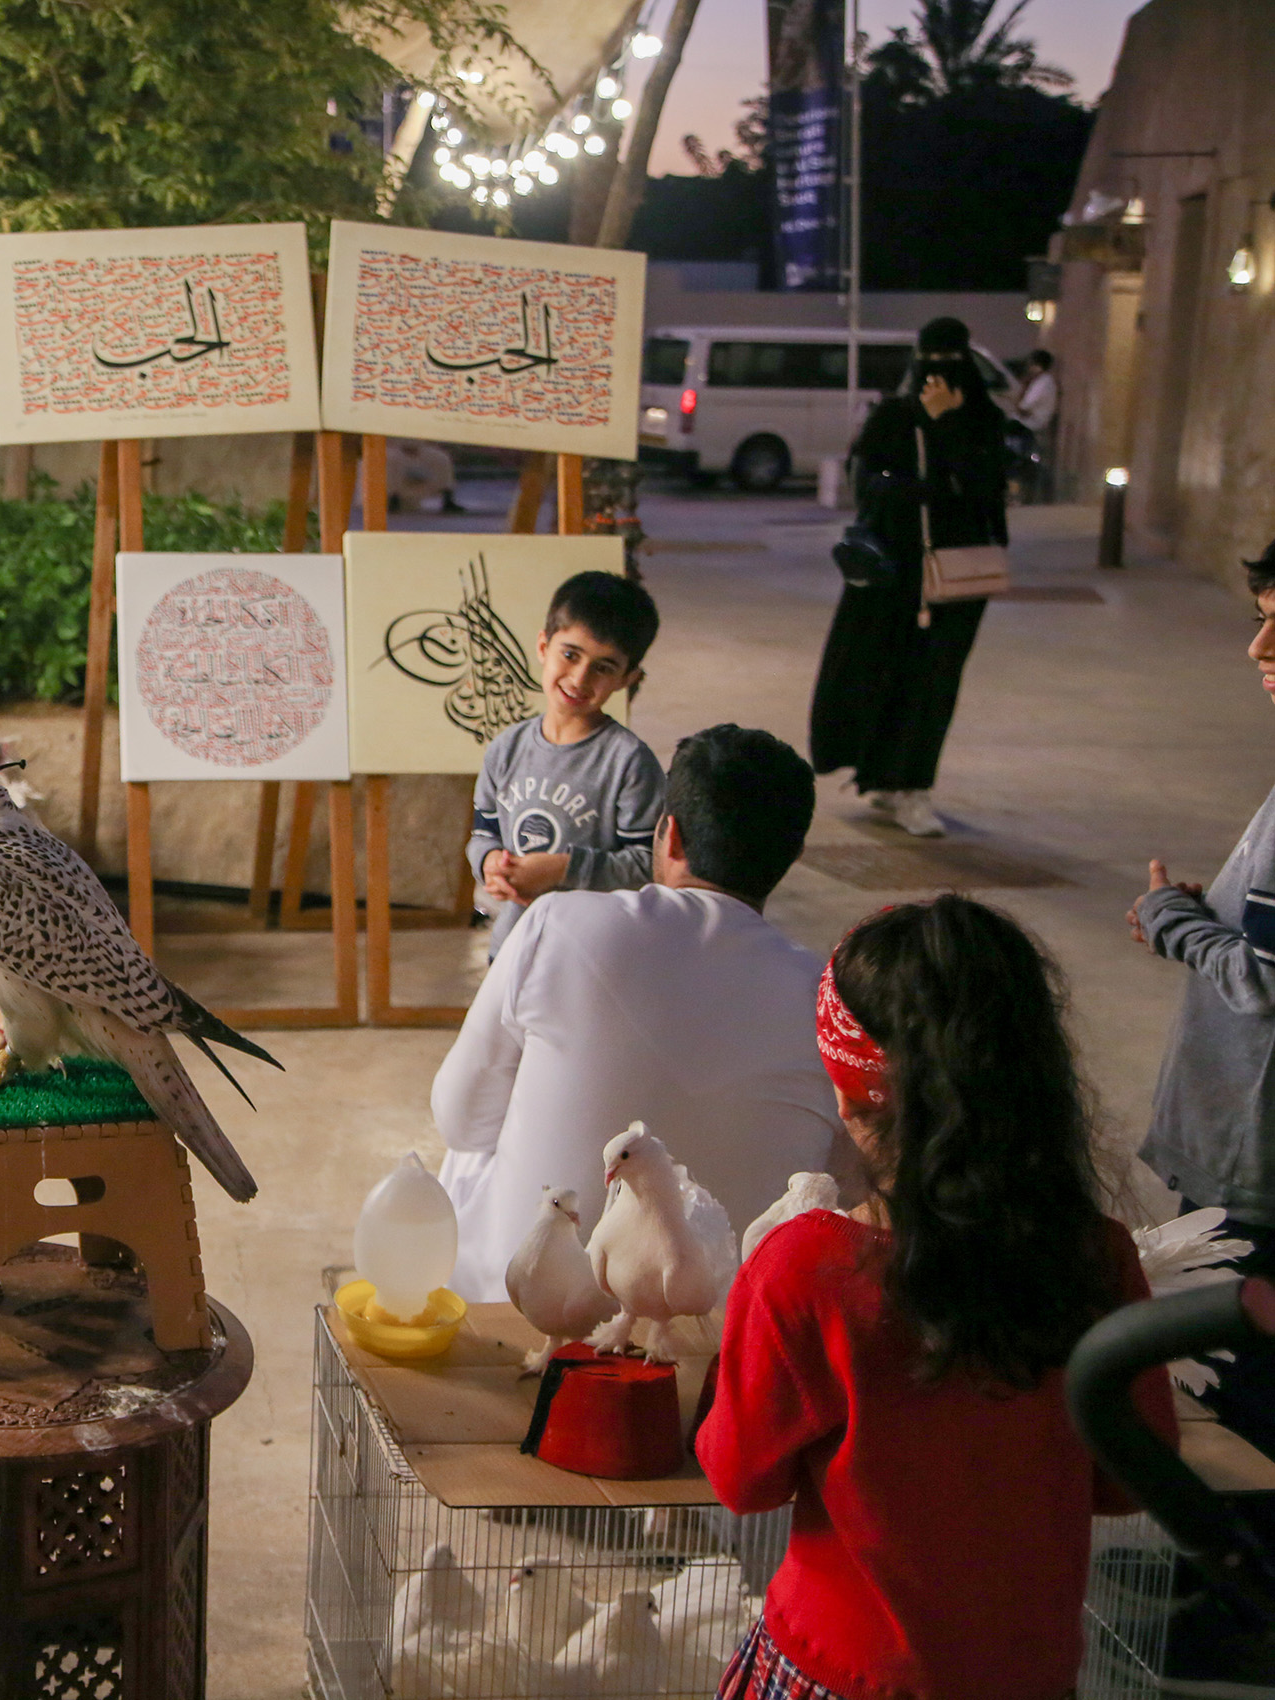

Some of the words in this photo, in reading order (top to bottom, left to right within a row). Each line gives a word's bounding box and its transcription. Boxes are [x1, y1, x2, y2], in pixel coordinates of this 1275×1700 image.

[91, 279, 230, 380] الحب
[425, 291, 559, 385] الحب
[497, 776, 599, 828] EXPLORE
